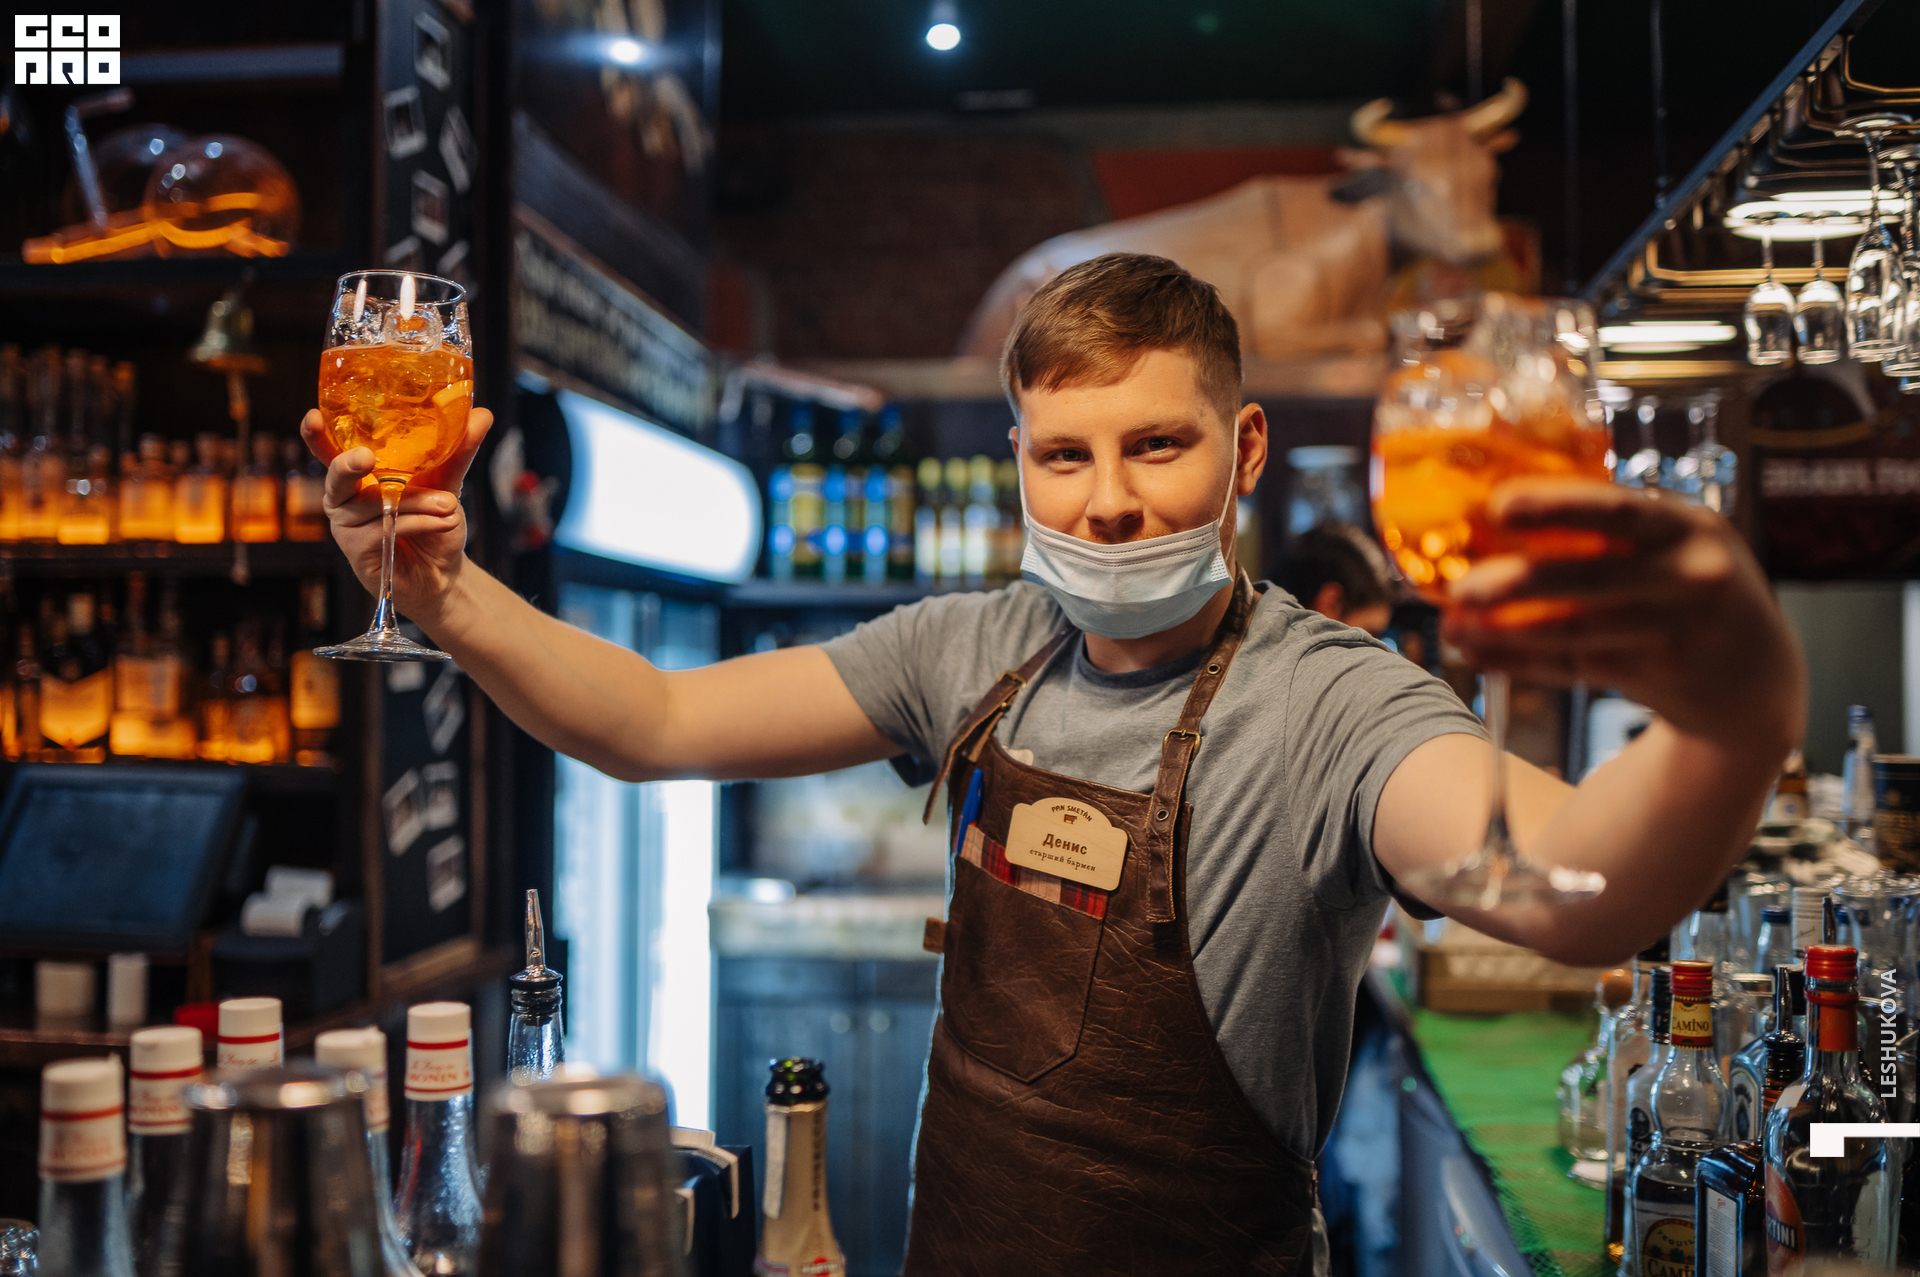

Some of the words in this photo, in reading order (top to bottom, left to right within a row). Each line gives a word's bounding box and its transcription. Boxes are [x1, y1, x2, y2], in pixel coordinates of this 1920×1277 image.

[1042, 833, 1088, 855] Денис
[1029, 849, 1065, 863] старший
[1066, 856, 1097, 871] бармен
